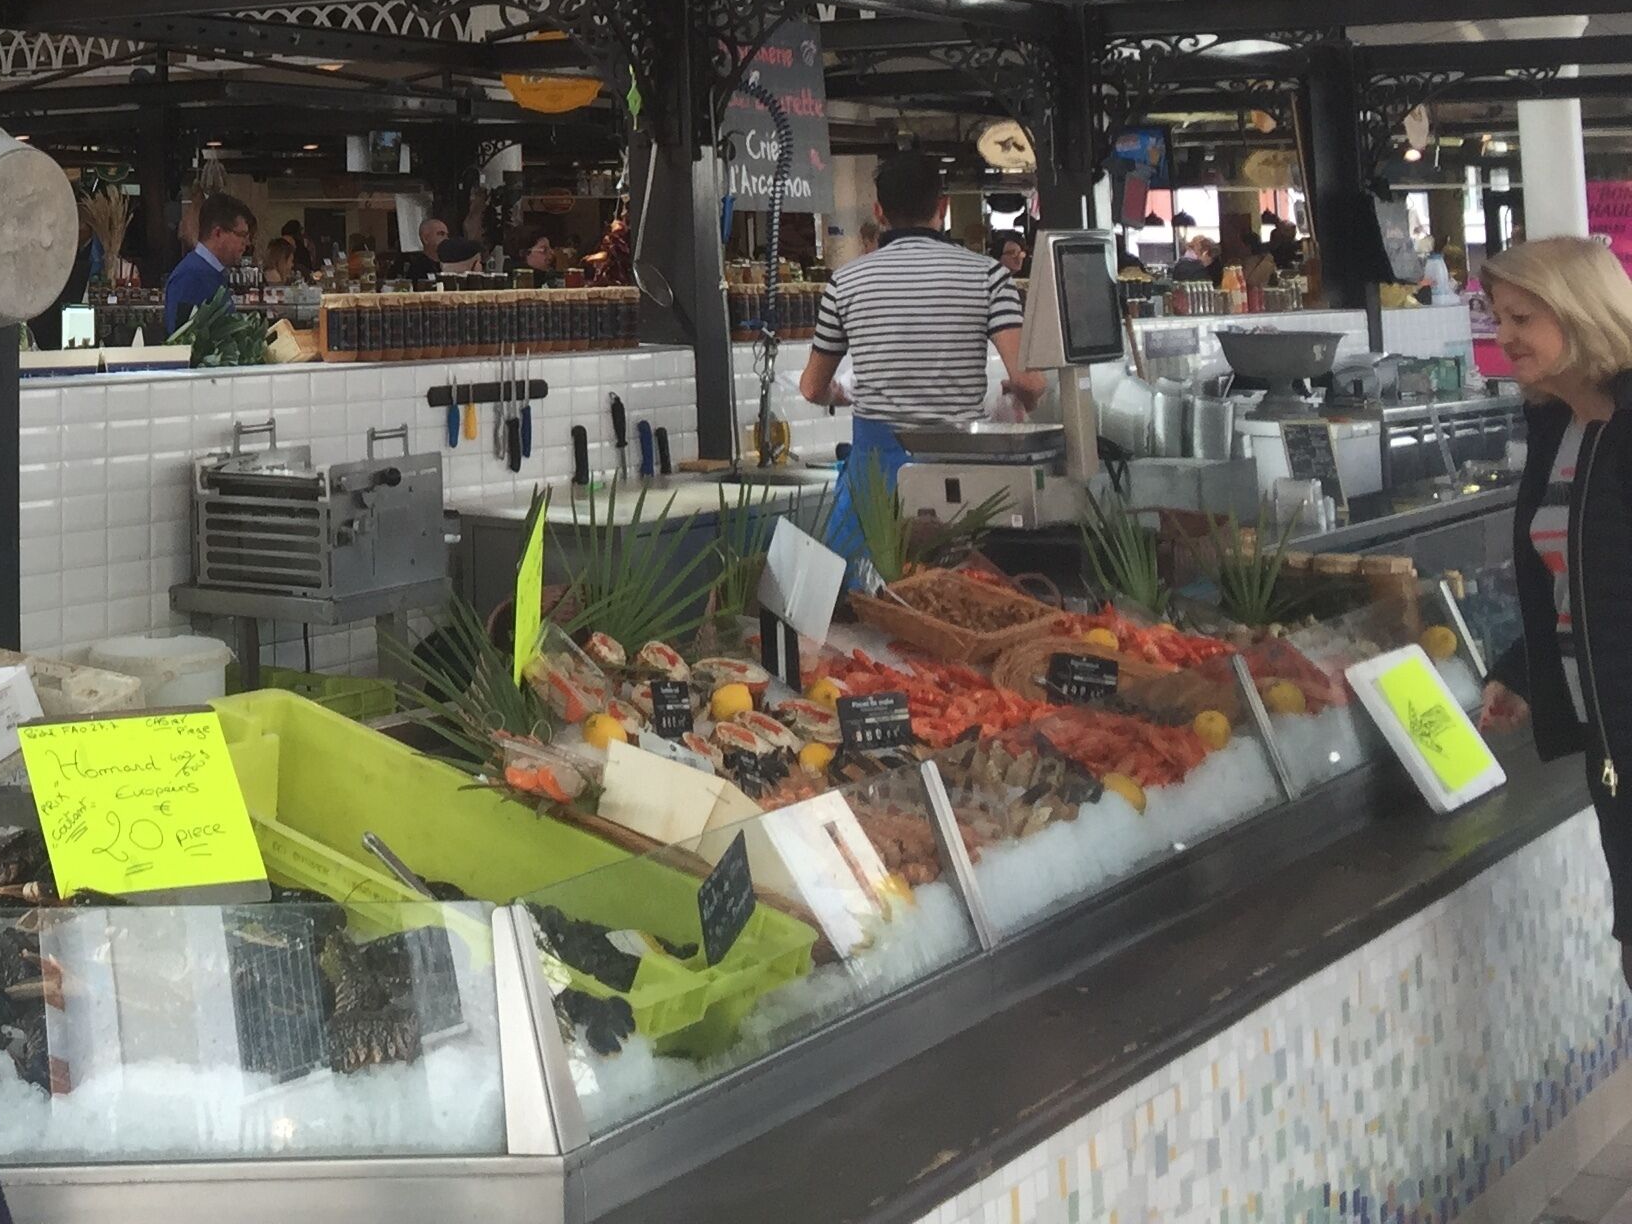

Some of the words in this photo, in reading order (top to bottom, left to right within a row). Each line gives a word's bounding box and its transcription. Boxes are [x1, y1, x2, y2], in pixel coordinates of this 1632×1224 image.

[62, 725, 87, 735] FAO
[45, 749, 161, 780] Homard
[92, 810, 163, 863] 20
